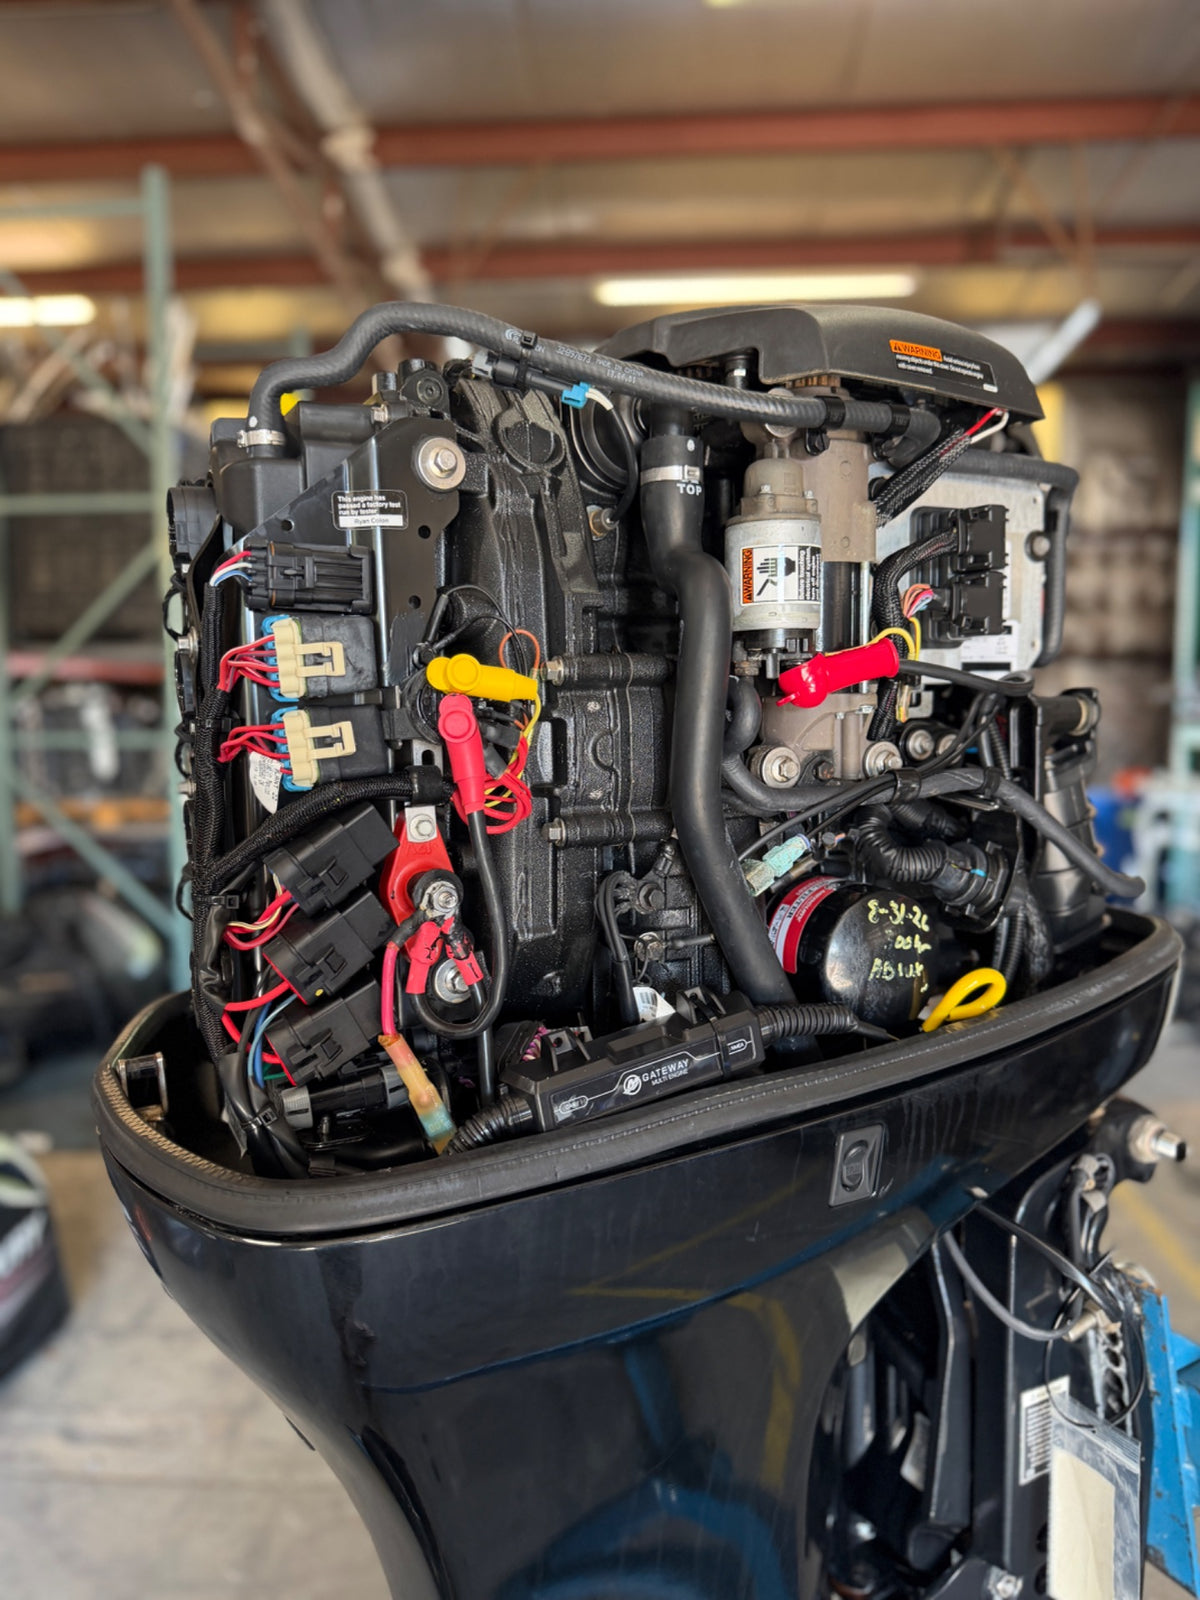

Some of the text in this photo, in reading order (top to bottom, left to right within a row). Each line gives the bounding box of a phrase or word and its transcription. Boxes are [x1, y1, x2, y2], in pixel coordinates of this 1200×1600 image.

[903, 345, 941, 359] WARNING
[676, 482, 702, 496] TOP
[337, 495, 351, 503] This
[352, 495, 373, 503] engine
[338, 502, 361, 510] passed
[366, 501, 388, 509] factory
[743, 549, 752, 594] WARNING
[642, 1059, 690, 1083] GATEWAY
[651, 1068, 690, 1086] MULTI ENGINE
